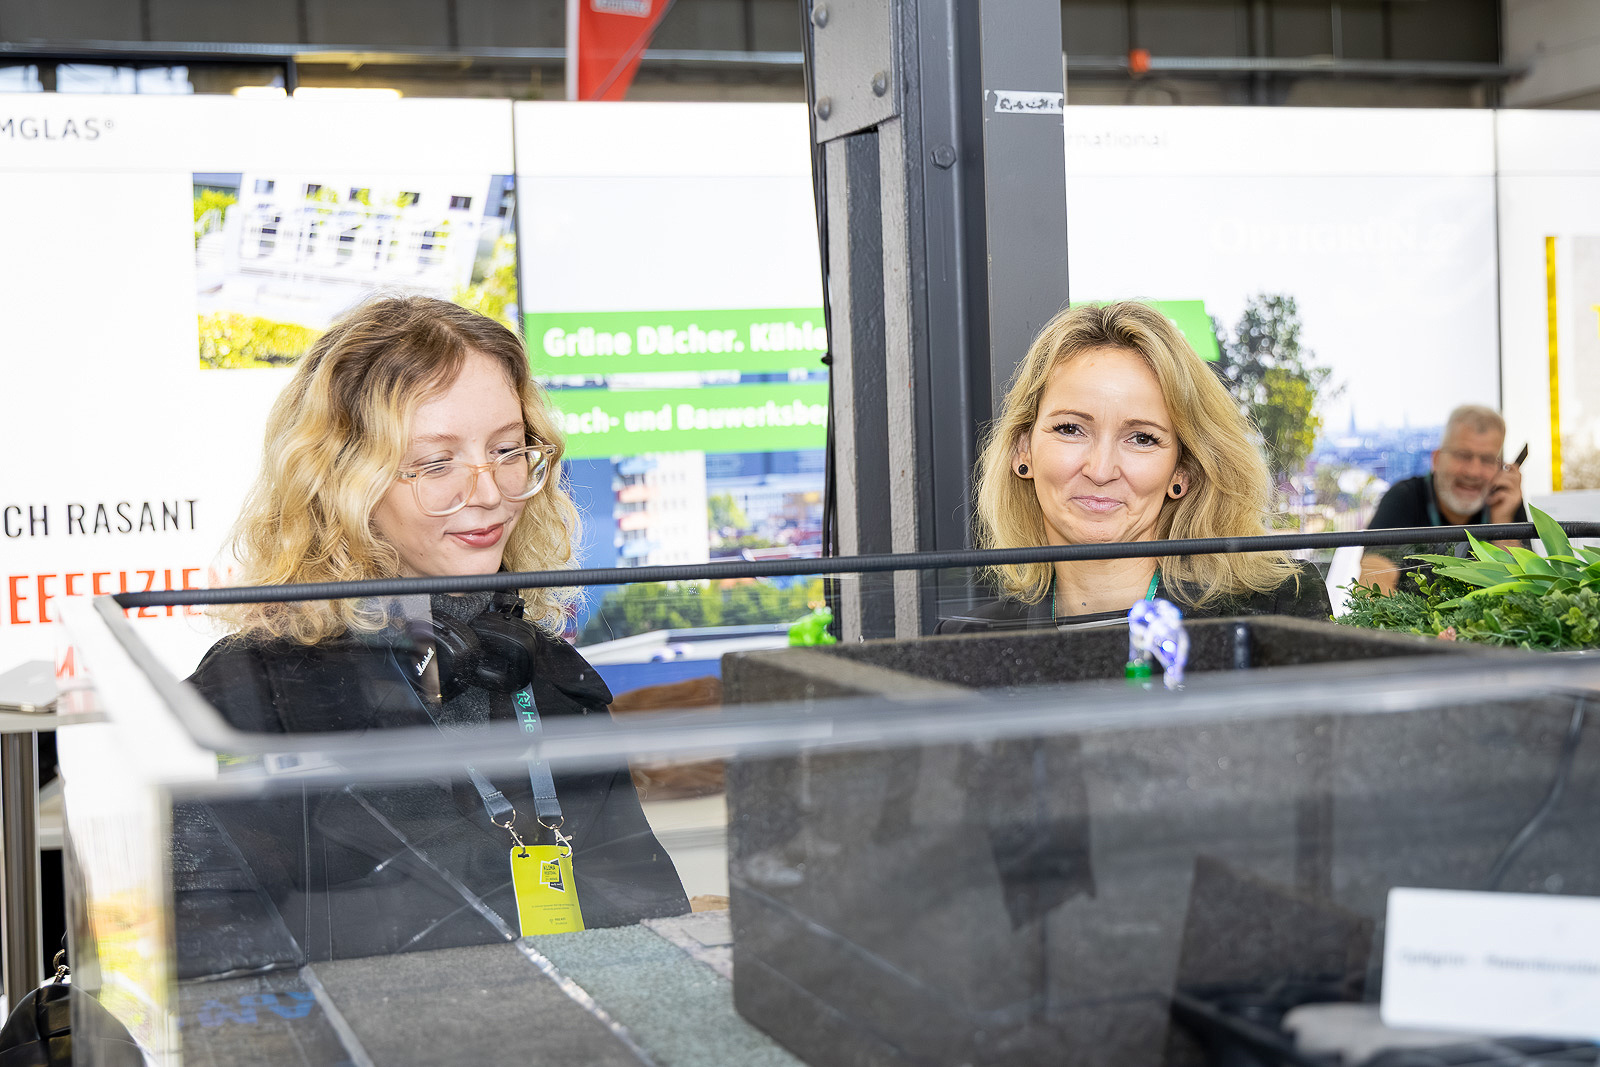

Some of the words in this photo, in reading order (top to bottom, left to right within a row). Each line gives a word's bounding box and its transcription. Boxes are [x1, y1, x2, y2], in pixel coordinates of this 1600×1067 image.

[543, 327, 632, 358] Grüne
[637, 324, 745, 355] Dächer.
[624, 404, 673, 433] und
[67, 499, 199, 536] RASANT
